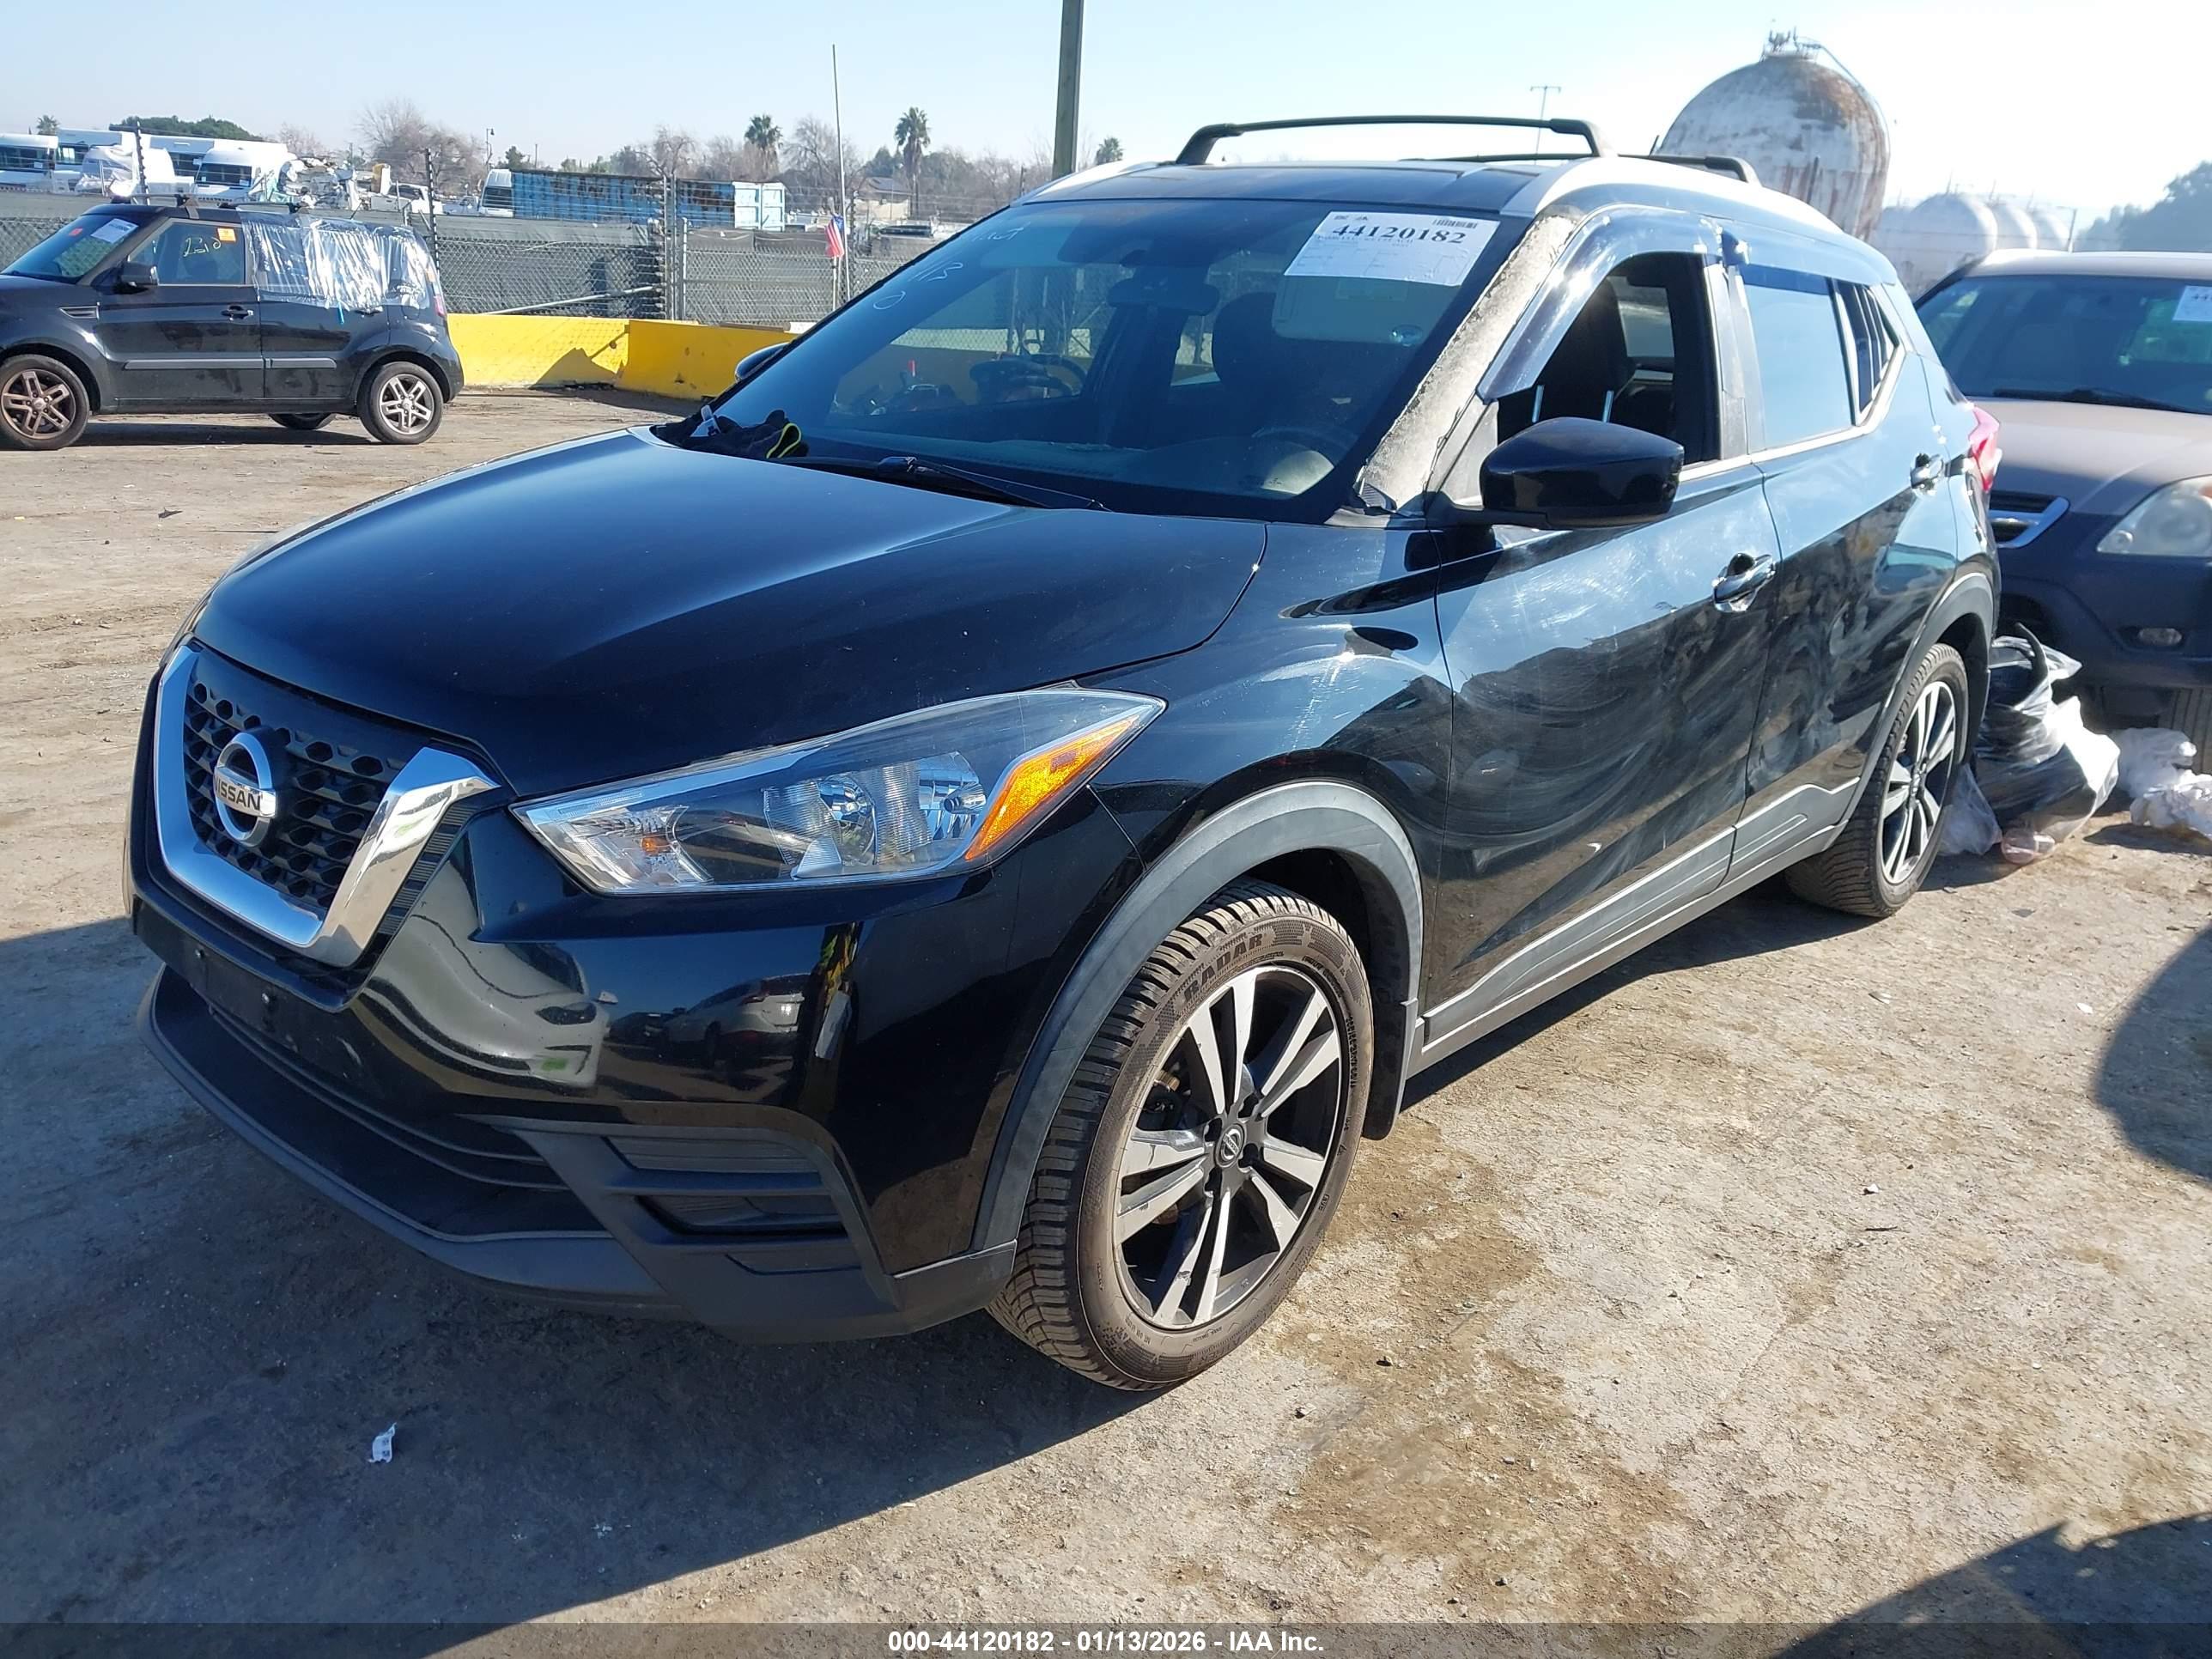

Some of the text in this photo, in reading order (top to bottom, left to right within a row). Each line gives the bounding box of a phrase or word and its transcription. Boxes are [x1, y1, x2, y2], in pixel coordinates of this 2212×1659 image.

[1332, 224, 1467, 244] 44120182
[213, 775, 261, 811] NISSAN
[1183, 933, 1263, 1002] RADAR
